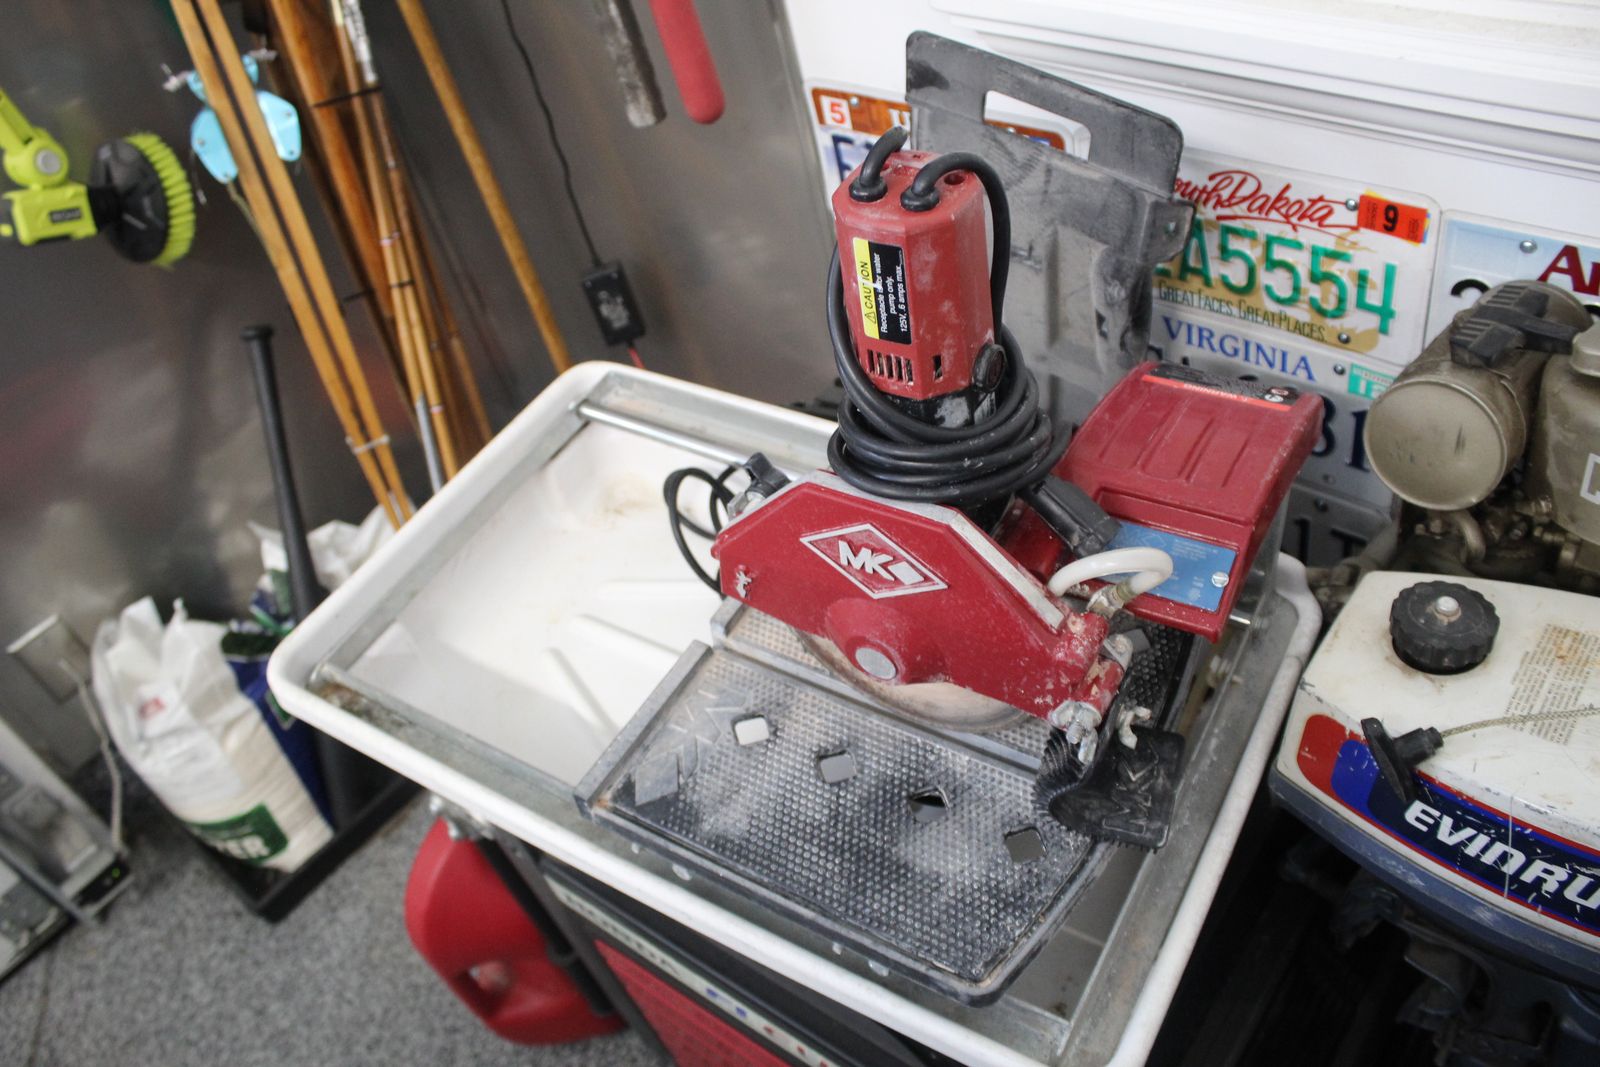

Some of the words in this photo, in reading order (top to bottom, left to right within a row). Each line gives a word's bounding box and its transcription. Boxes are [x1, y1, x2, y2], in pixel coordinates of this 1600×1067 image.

[829, 101, 846, 125] 5
[1174, 176, 1231, 211] outh
[1208, 170, 1346, 230] Dakota
[1383, 204, 1400, 231] 9
[873, 252, 881, 274] water
[1155, 218, 1397, 336] A5554
[860, 261, 875, 309] CAUION
[888, 293, 897, 315] pump
[897, 282, 906, 304] amps
[1157, 280, 1197, 308] GREAT
[1237, 299, 1279, 328] GREAT
[877, 294, 888, 333] Receptacle
[1161, 315, 1316, 382] VIRGINIA
[838, 540, 900, 581] MK
